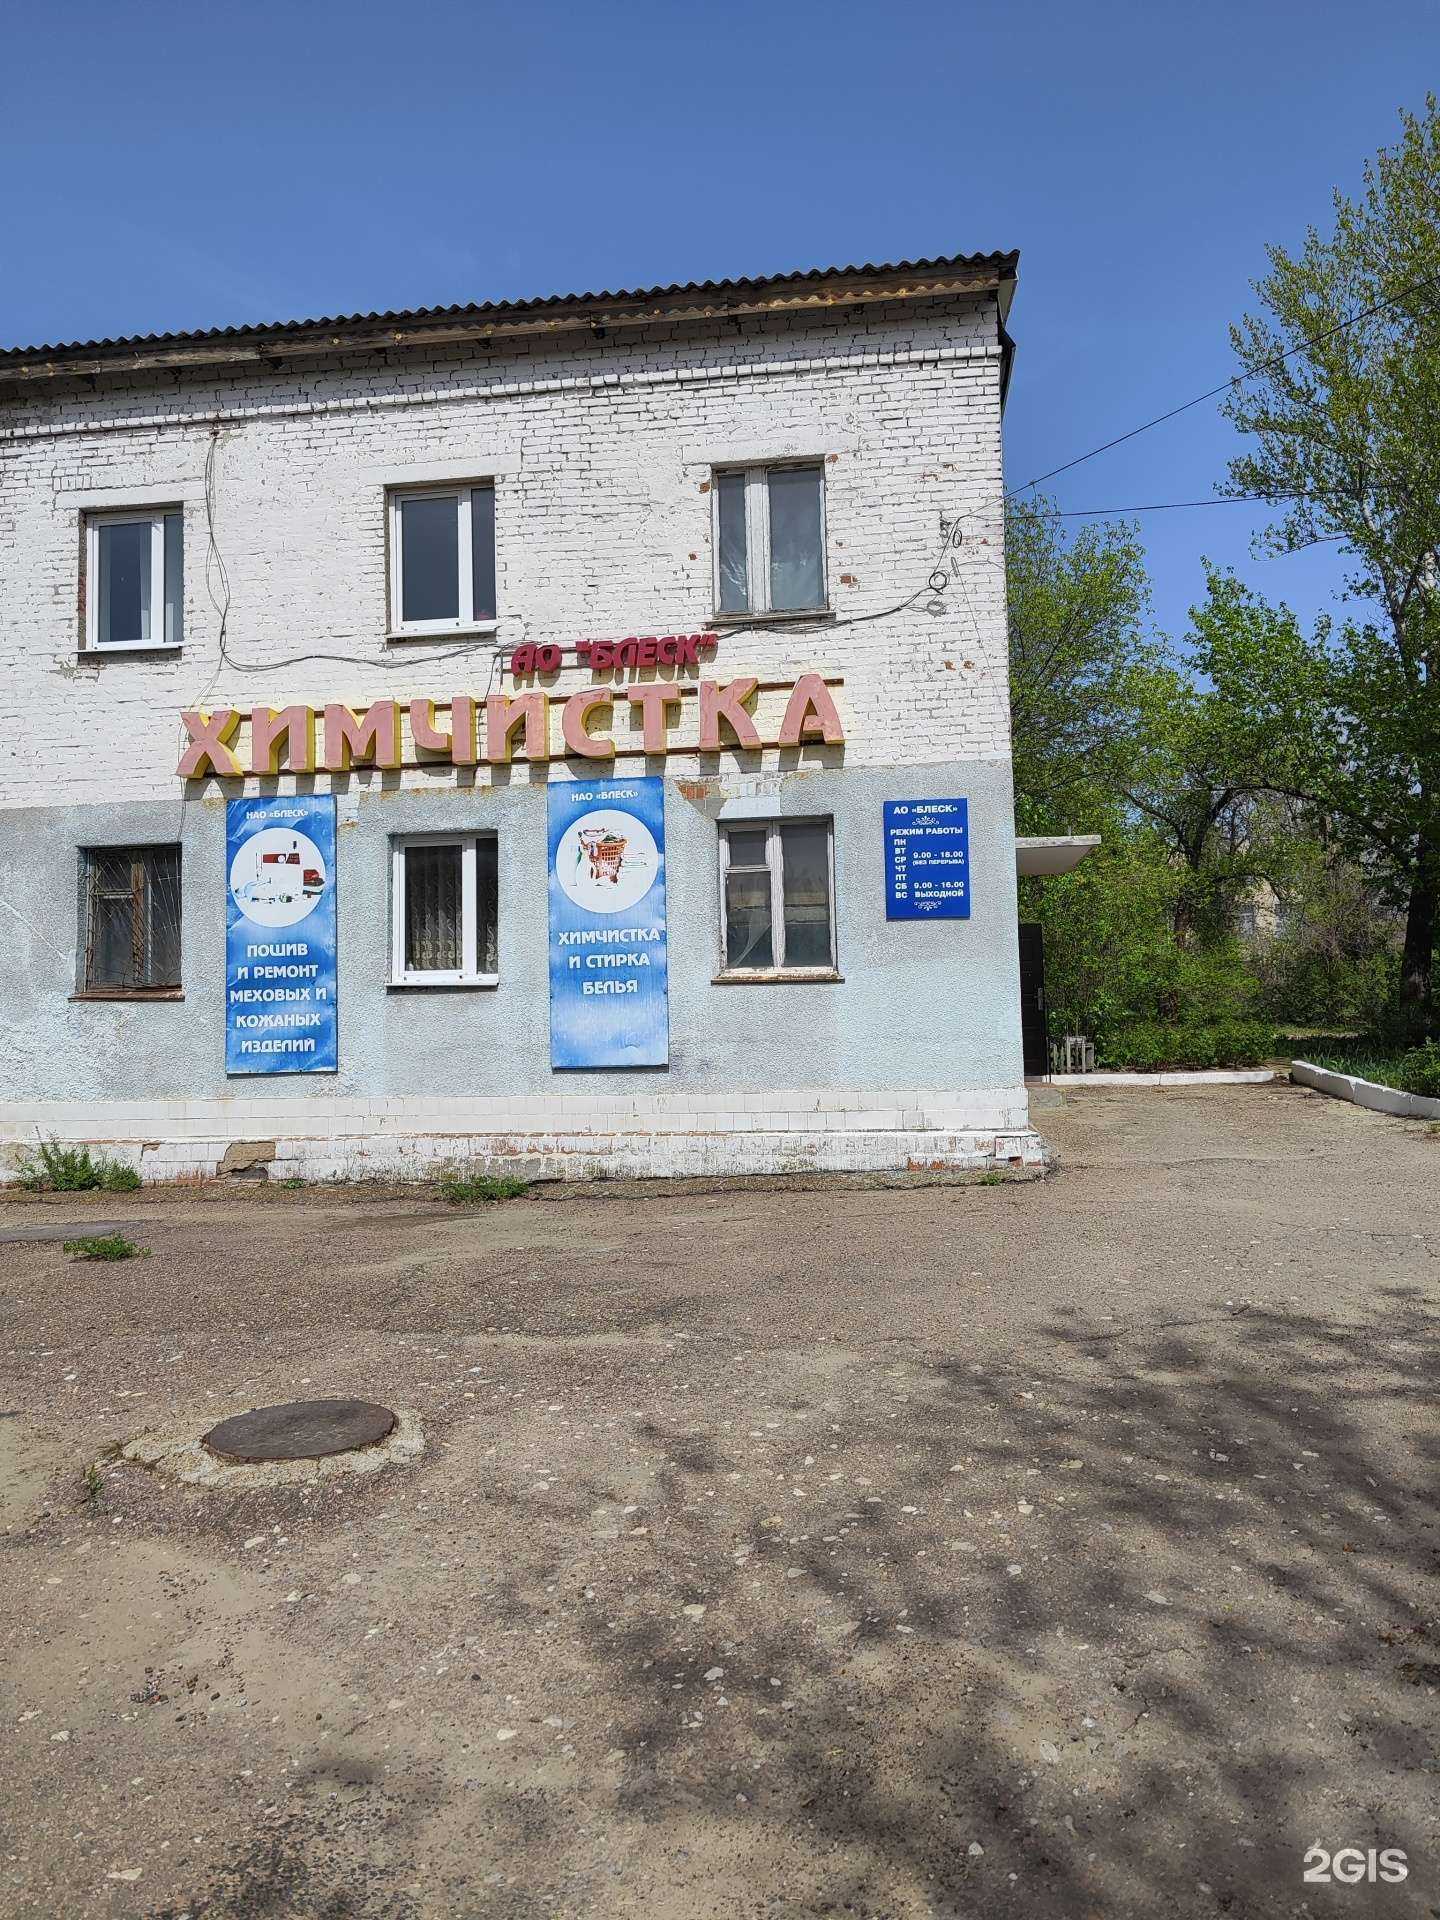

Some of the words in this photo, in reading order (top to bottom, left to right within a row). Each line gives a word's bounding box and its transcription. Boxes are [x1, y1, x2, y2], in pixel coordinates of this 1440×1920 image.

[510, 643, 562, 676] АО
[175, 673, 846, 780] ХИМЧИСТКА
[571, 793, 594, 801] НАО
[597, 790, 639, 799] «БЛЕСК»
[246, 811, 267, 820] НАО
[269, 808, 308, 818] «БЛЕСК»
[894, 806, 908, 814] АО
[912, 804, 957, 814] «БЛЕСК»
[890, 828, 923, 836] РЕЖИМ
[915, 890, 964, 898] ВЫХОДНОЙ
[558, 928, 661, 946] ХИМЧИСТКА
[247, 943, 308, 958] ПОШИВ
[569, 956, 581, 969] И
[586, 952, 650, 968] СТИРКА
[237, 966, 248, 980] И
[253, 964, 319, 979] РЕМОНТ
[230, 988, 310, 1002] МЕХОВЫХ
[315, 986, 327, 1000] И
[582, 979, 639, 995] БЕЛЬЯ
[236, 1013, 321, 1028] КОЖАНЫХ
[241, 1037, 315, 1053] ИЗДЕЛИЙ
